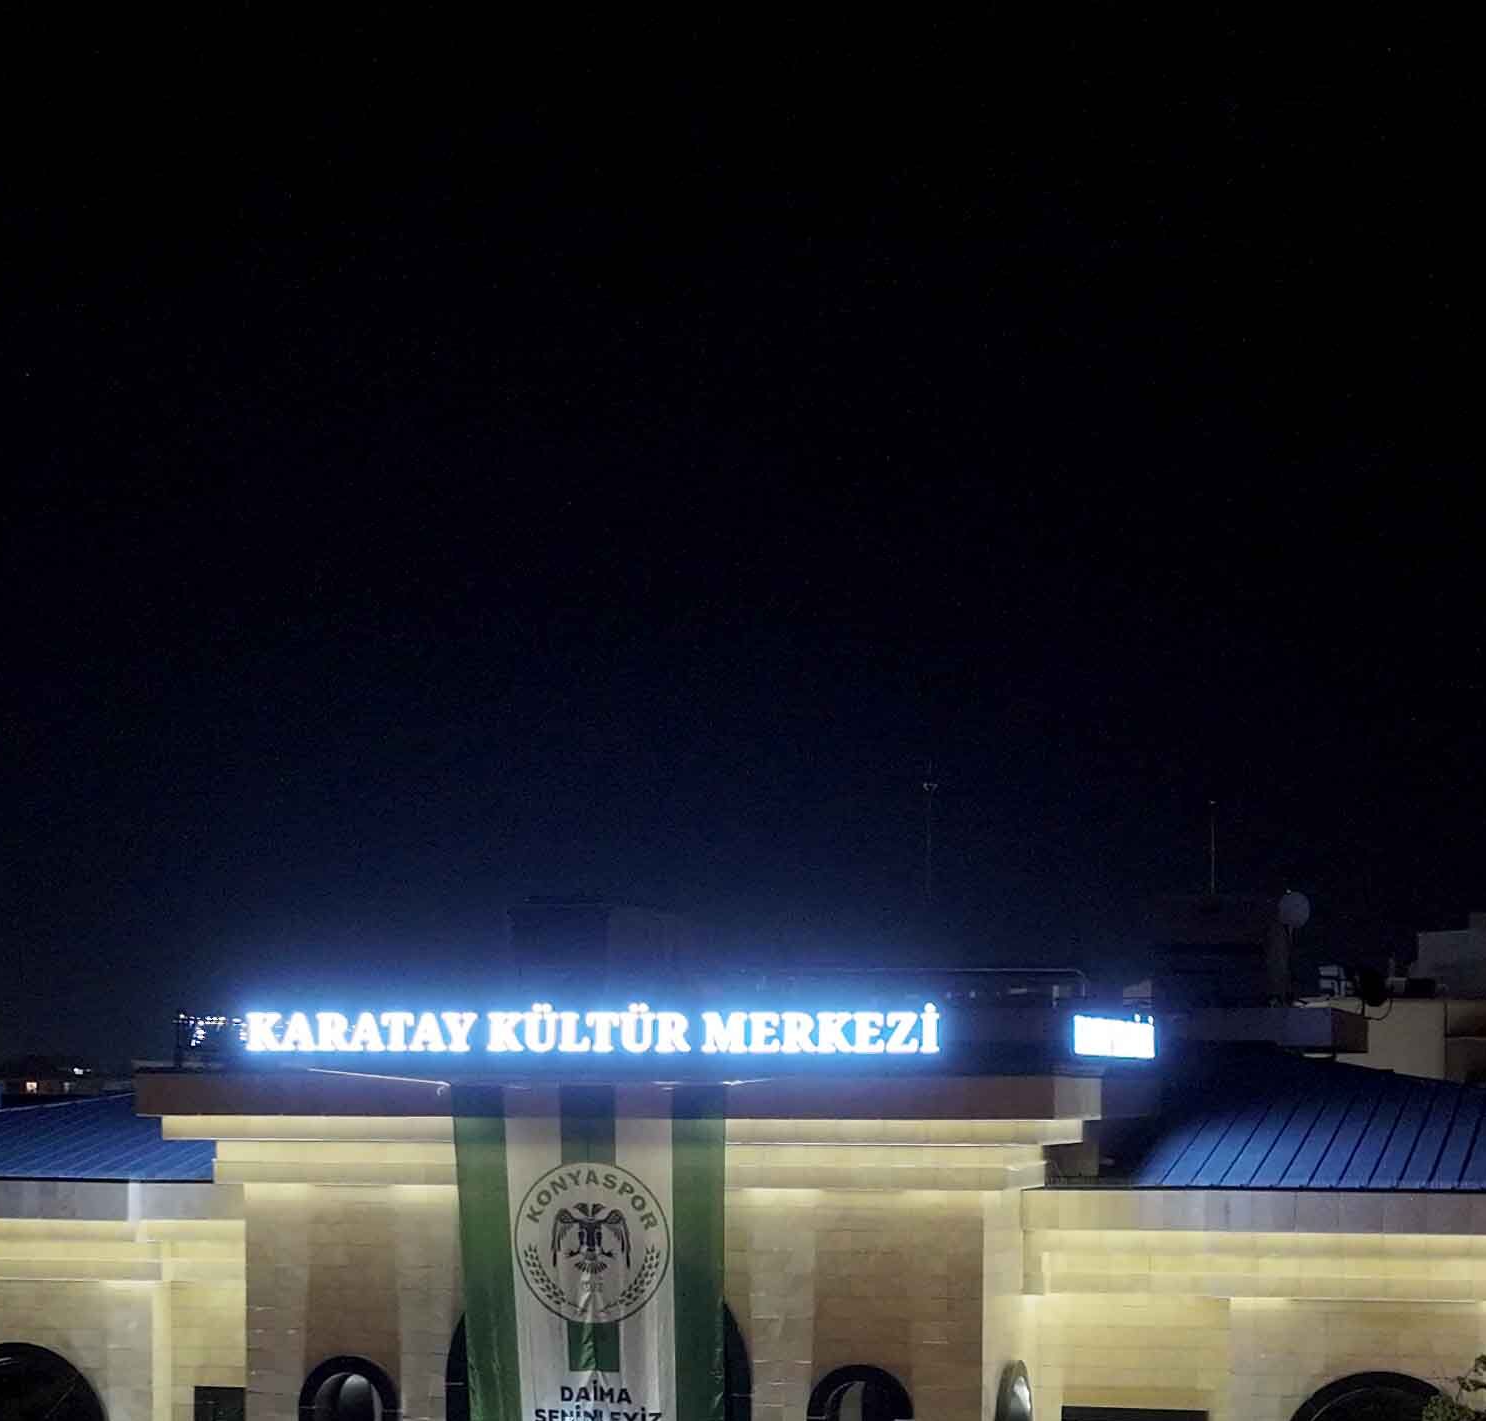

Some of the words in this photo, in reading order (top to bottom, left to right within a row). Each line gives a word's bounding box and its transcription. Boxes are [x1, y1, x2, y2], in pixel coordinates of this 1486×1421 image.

[245, 1011, 477, 1052] KARATAY
[486, 1003, 691, 1053] KÜLTÜR
[701, 1002, 940, 1053] MERKEZİ
[526, 1169, 659, 1231] KONYASPOR
[560, 1380, 632, 1404] DAİMA
